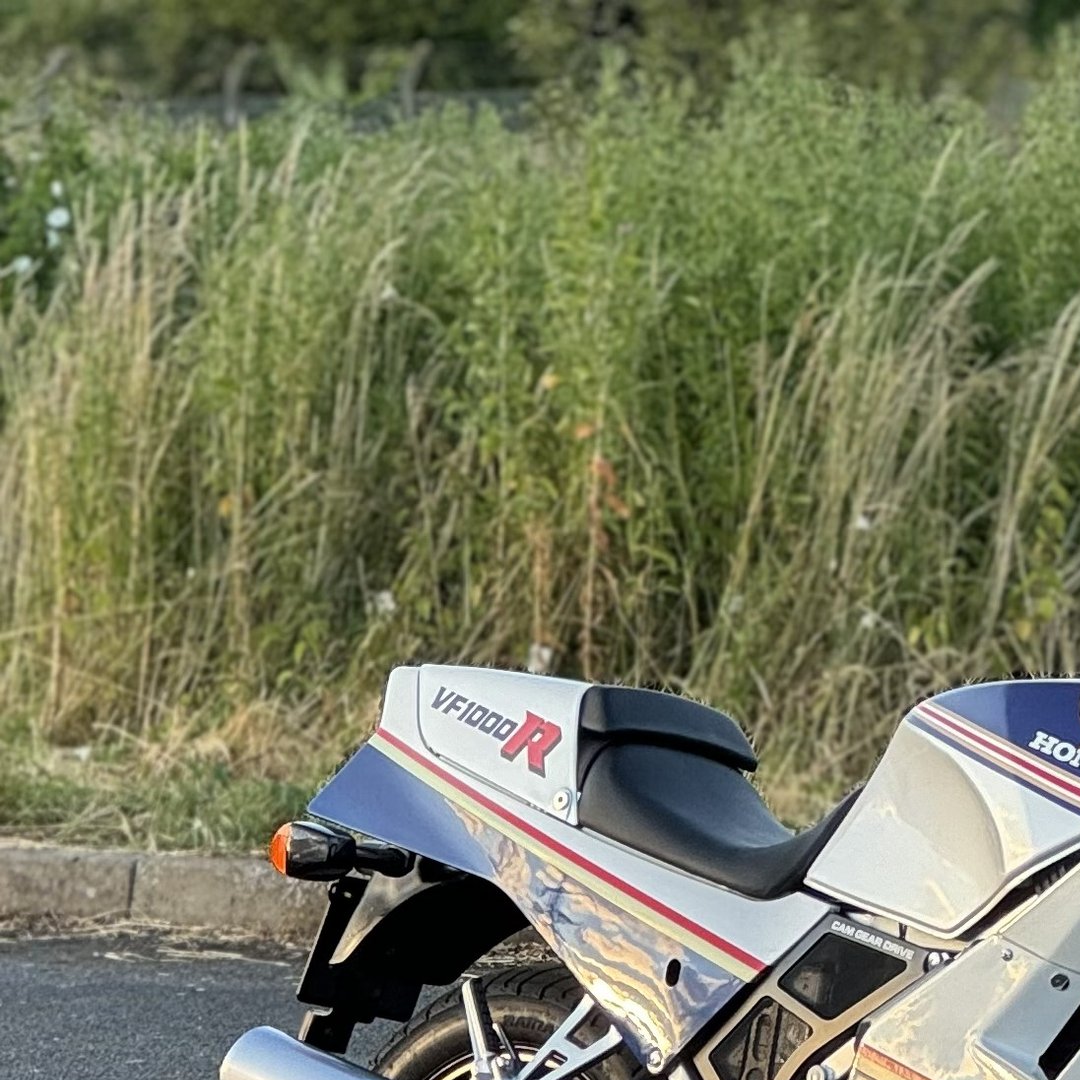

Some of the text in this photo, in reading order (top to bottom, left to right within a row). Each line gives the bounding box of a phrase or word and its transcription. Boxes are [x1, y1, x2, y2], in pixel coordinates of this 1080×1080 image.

[431, 686, 562, 778] VF1000R
[831, 920, 914, 960] CAM GEAR DRIVE
